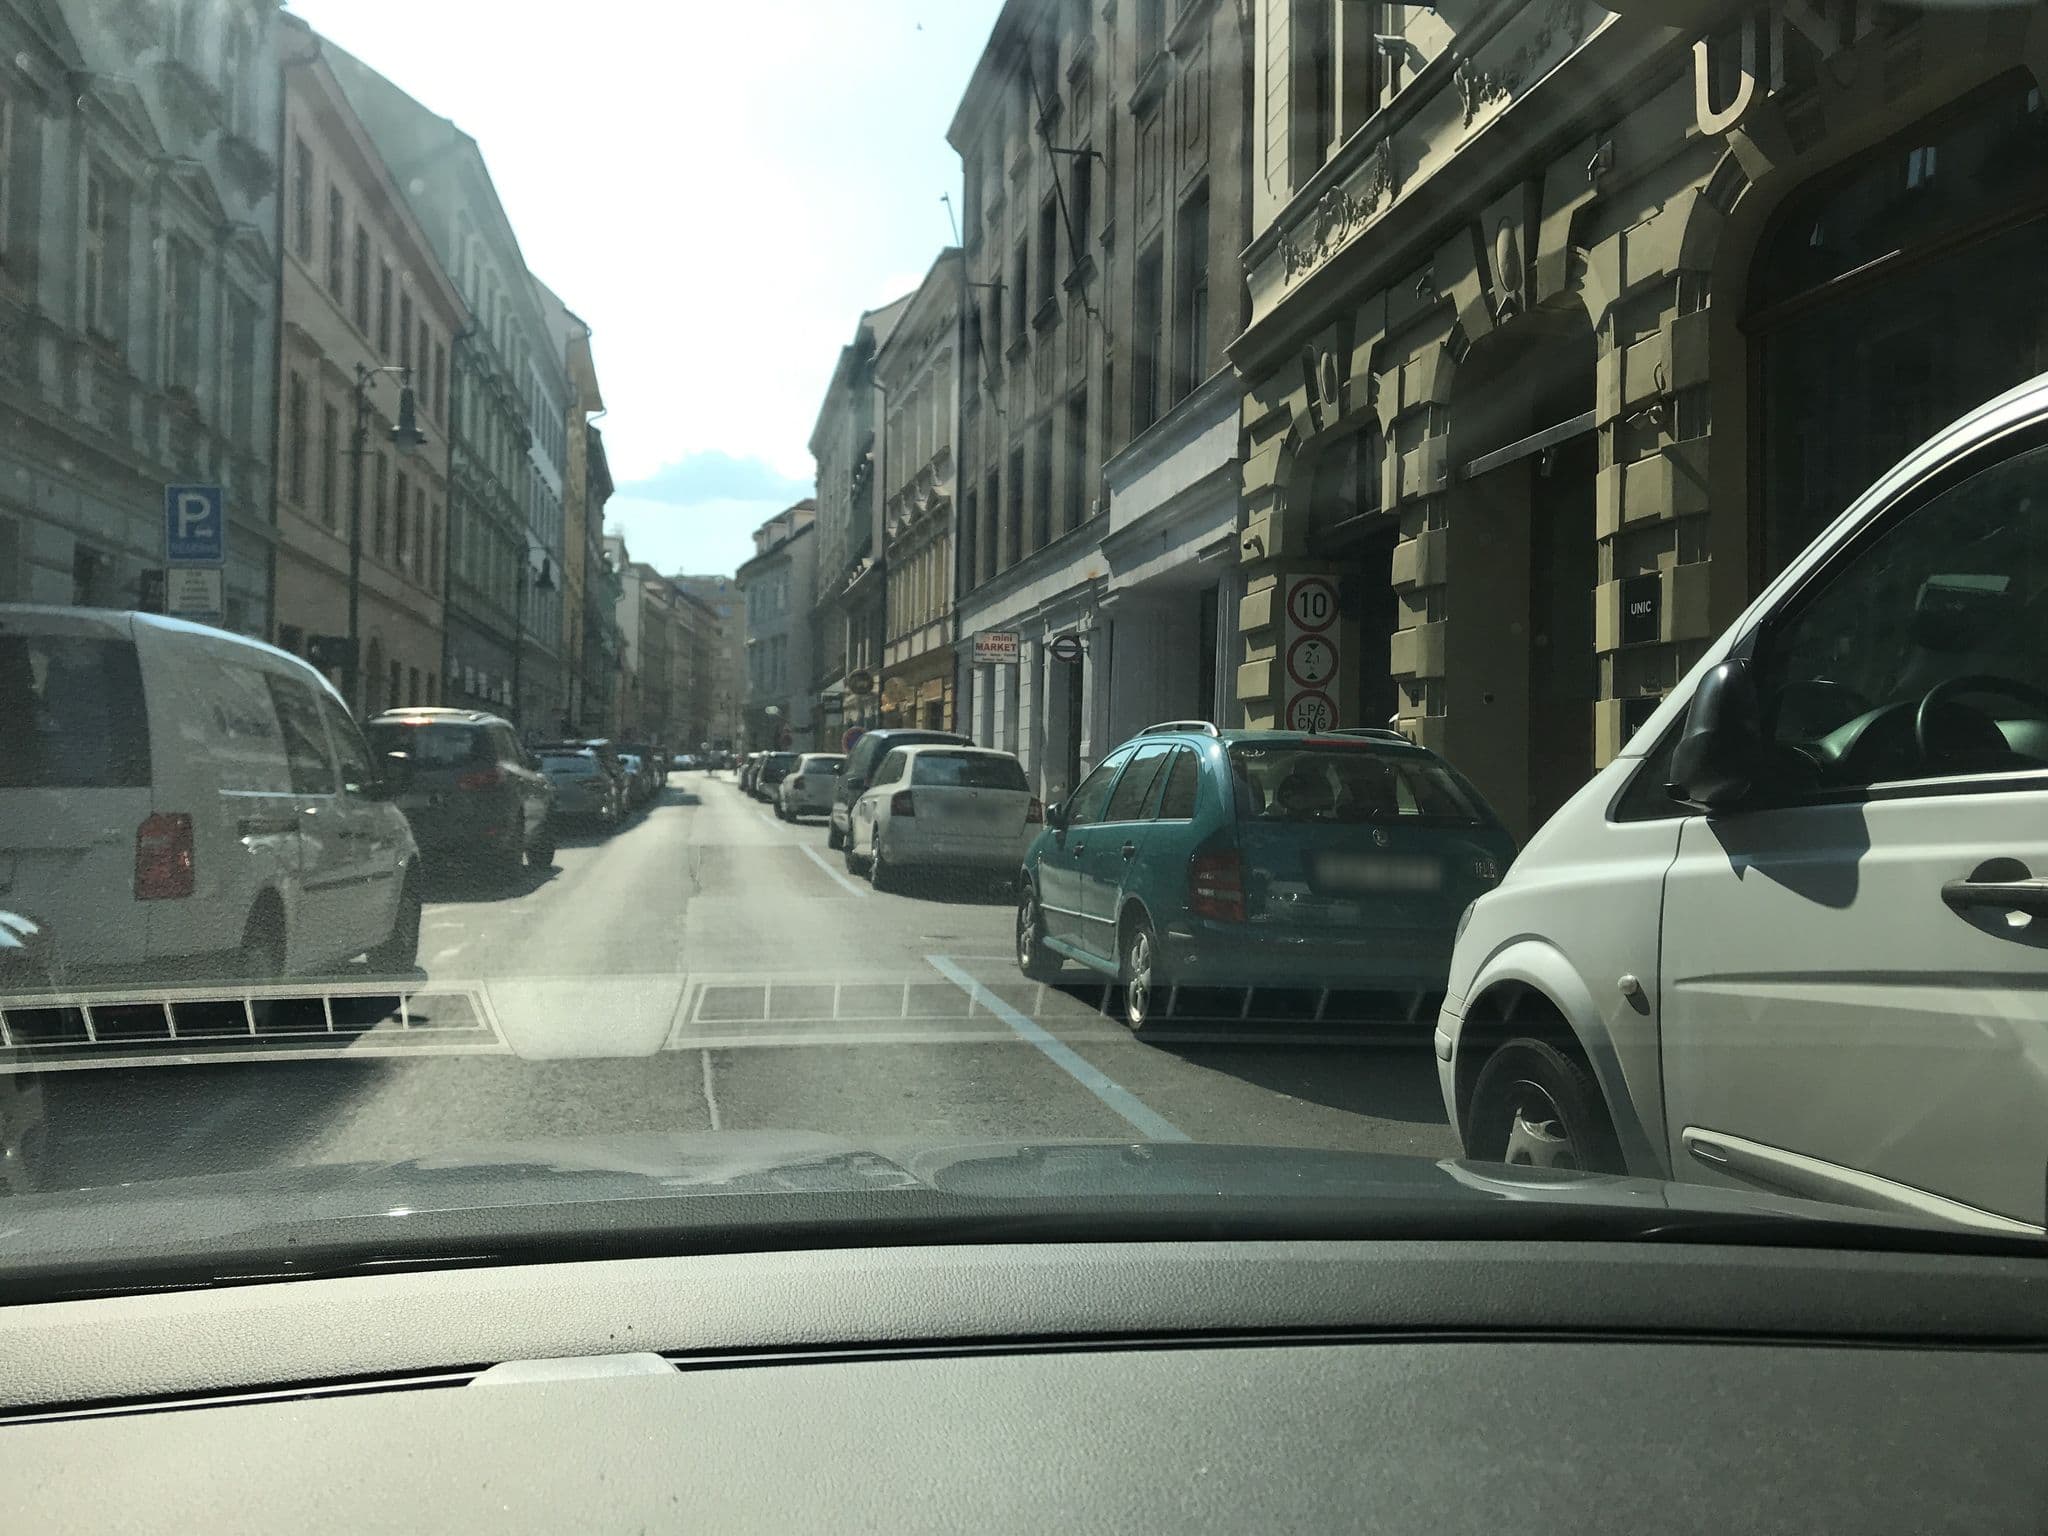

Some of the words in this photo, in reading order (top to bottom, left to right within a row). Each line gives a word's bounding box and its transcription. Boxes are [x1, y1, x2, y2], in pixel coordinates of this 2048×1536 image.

[178, 494, 211, 538] P
[1300, 591, 1327, 618] 10
[1630, 600, 1652, 615] UNIC
[992, 634, 1013, 642] mini
[975, 643, 1017, 652] MARKET
[1298, 703, 1326, 716] LPG
[1298, 717, 1327, 730] CNG
